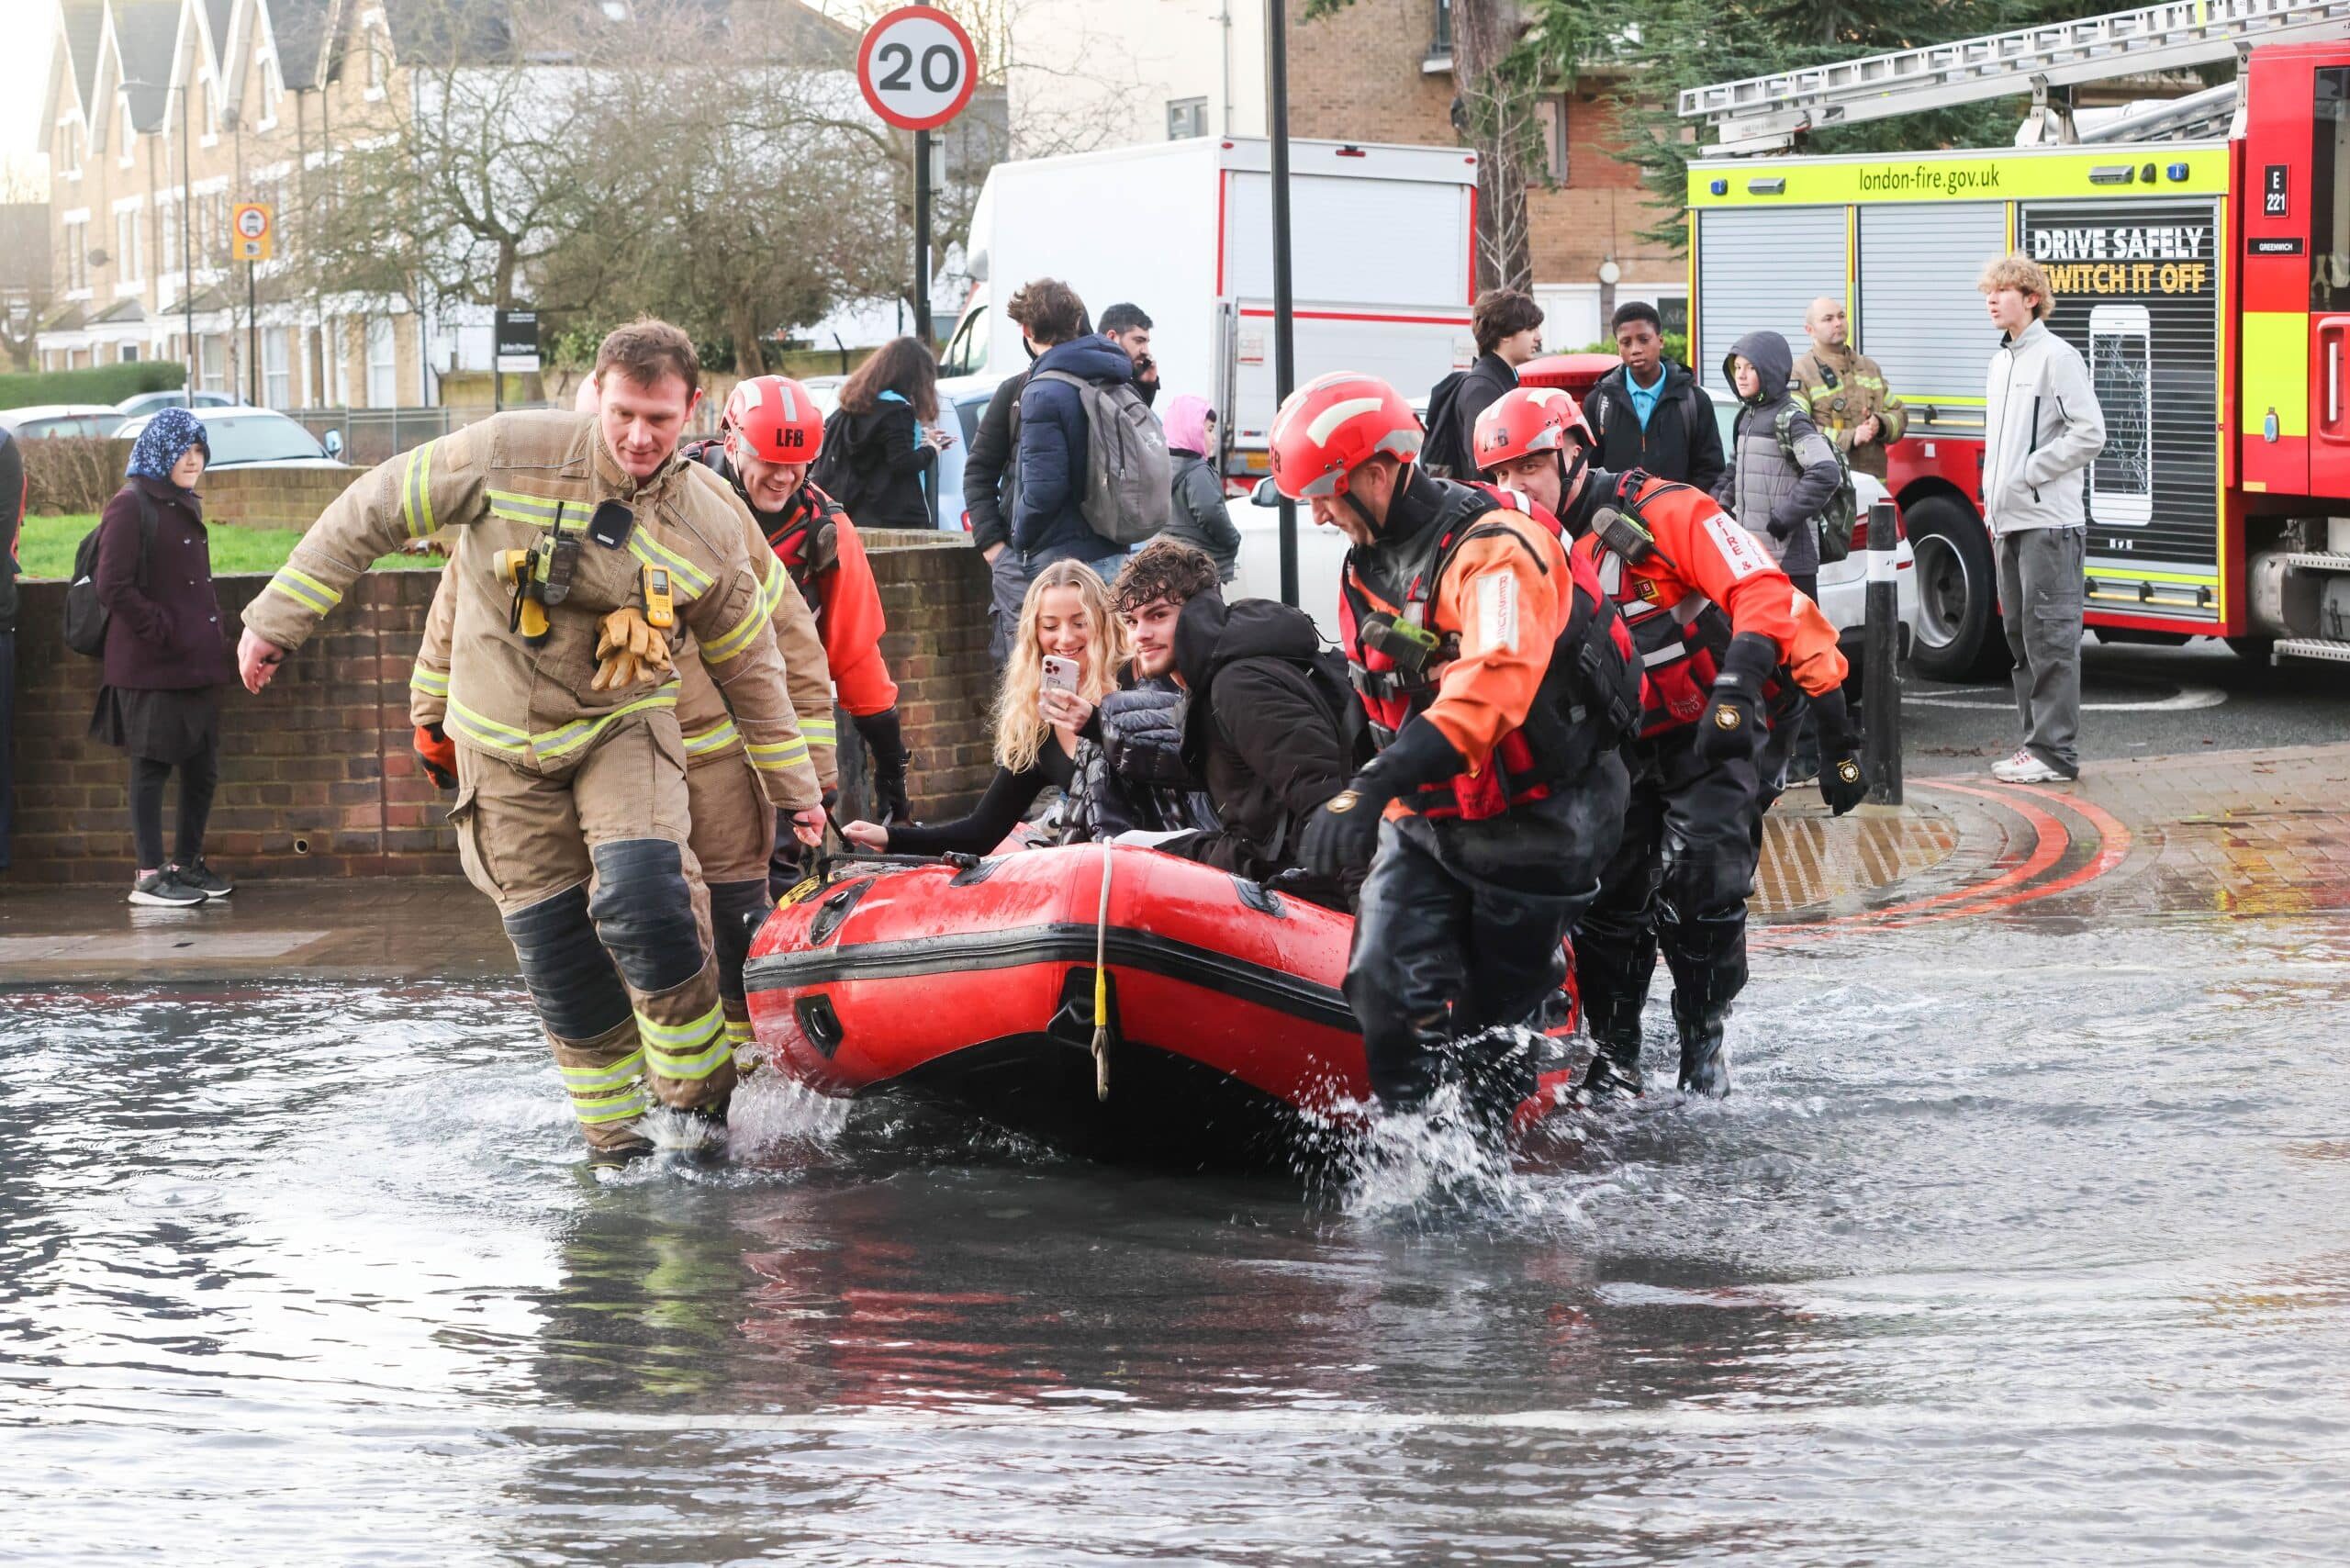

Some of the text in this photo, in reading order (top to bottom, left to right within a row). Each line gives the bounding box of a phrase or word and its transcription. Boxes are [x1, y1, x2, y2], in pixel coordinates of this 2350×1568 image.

[878, 42, 959, 93] 20
[1860, 163, 1999, 196] london-fire.gov.uk
[2273, 171, 2280, 189] E
[2266, 193, 2286, 211] 221
[2034, 227, 2204, 260] DRIVE SAFELY
[2259, 242, 2293, 252] GREENWICH
[2132, 263, 2154, 294] IT
[2159, 263, 2206, 294] OFF
[776, 428, 804, 447] LFB
[1715, 517, 1753, 571] FIRE &
